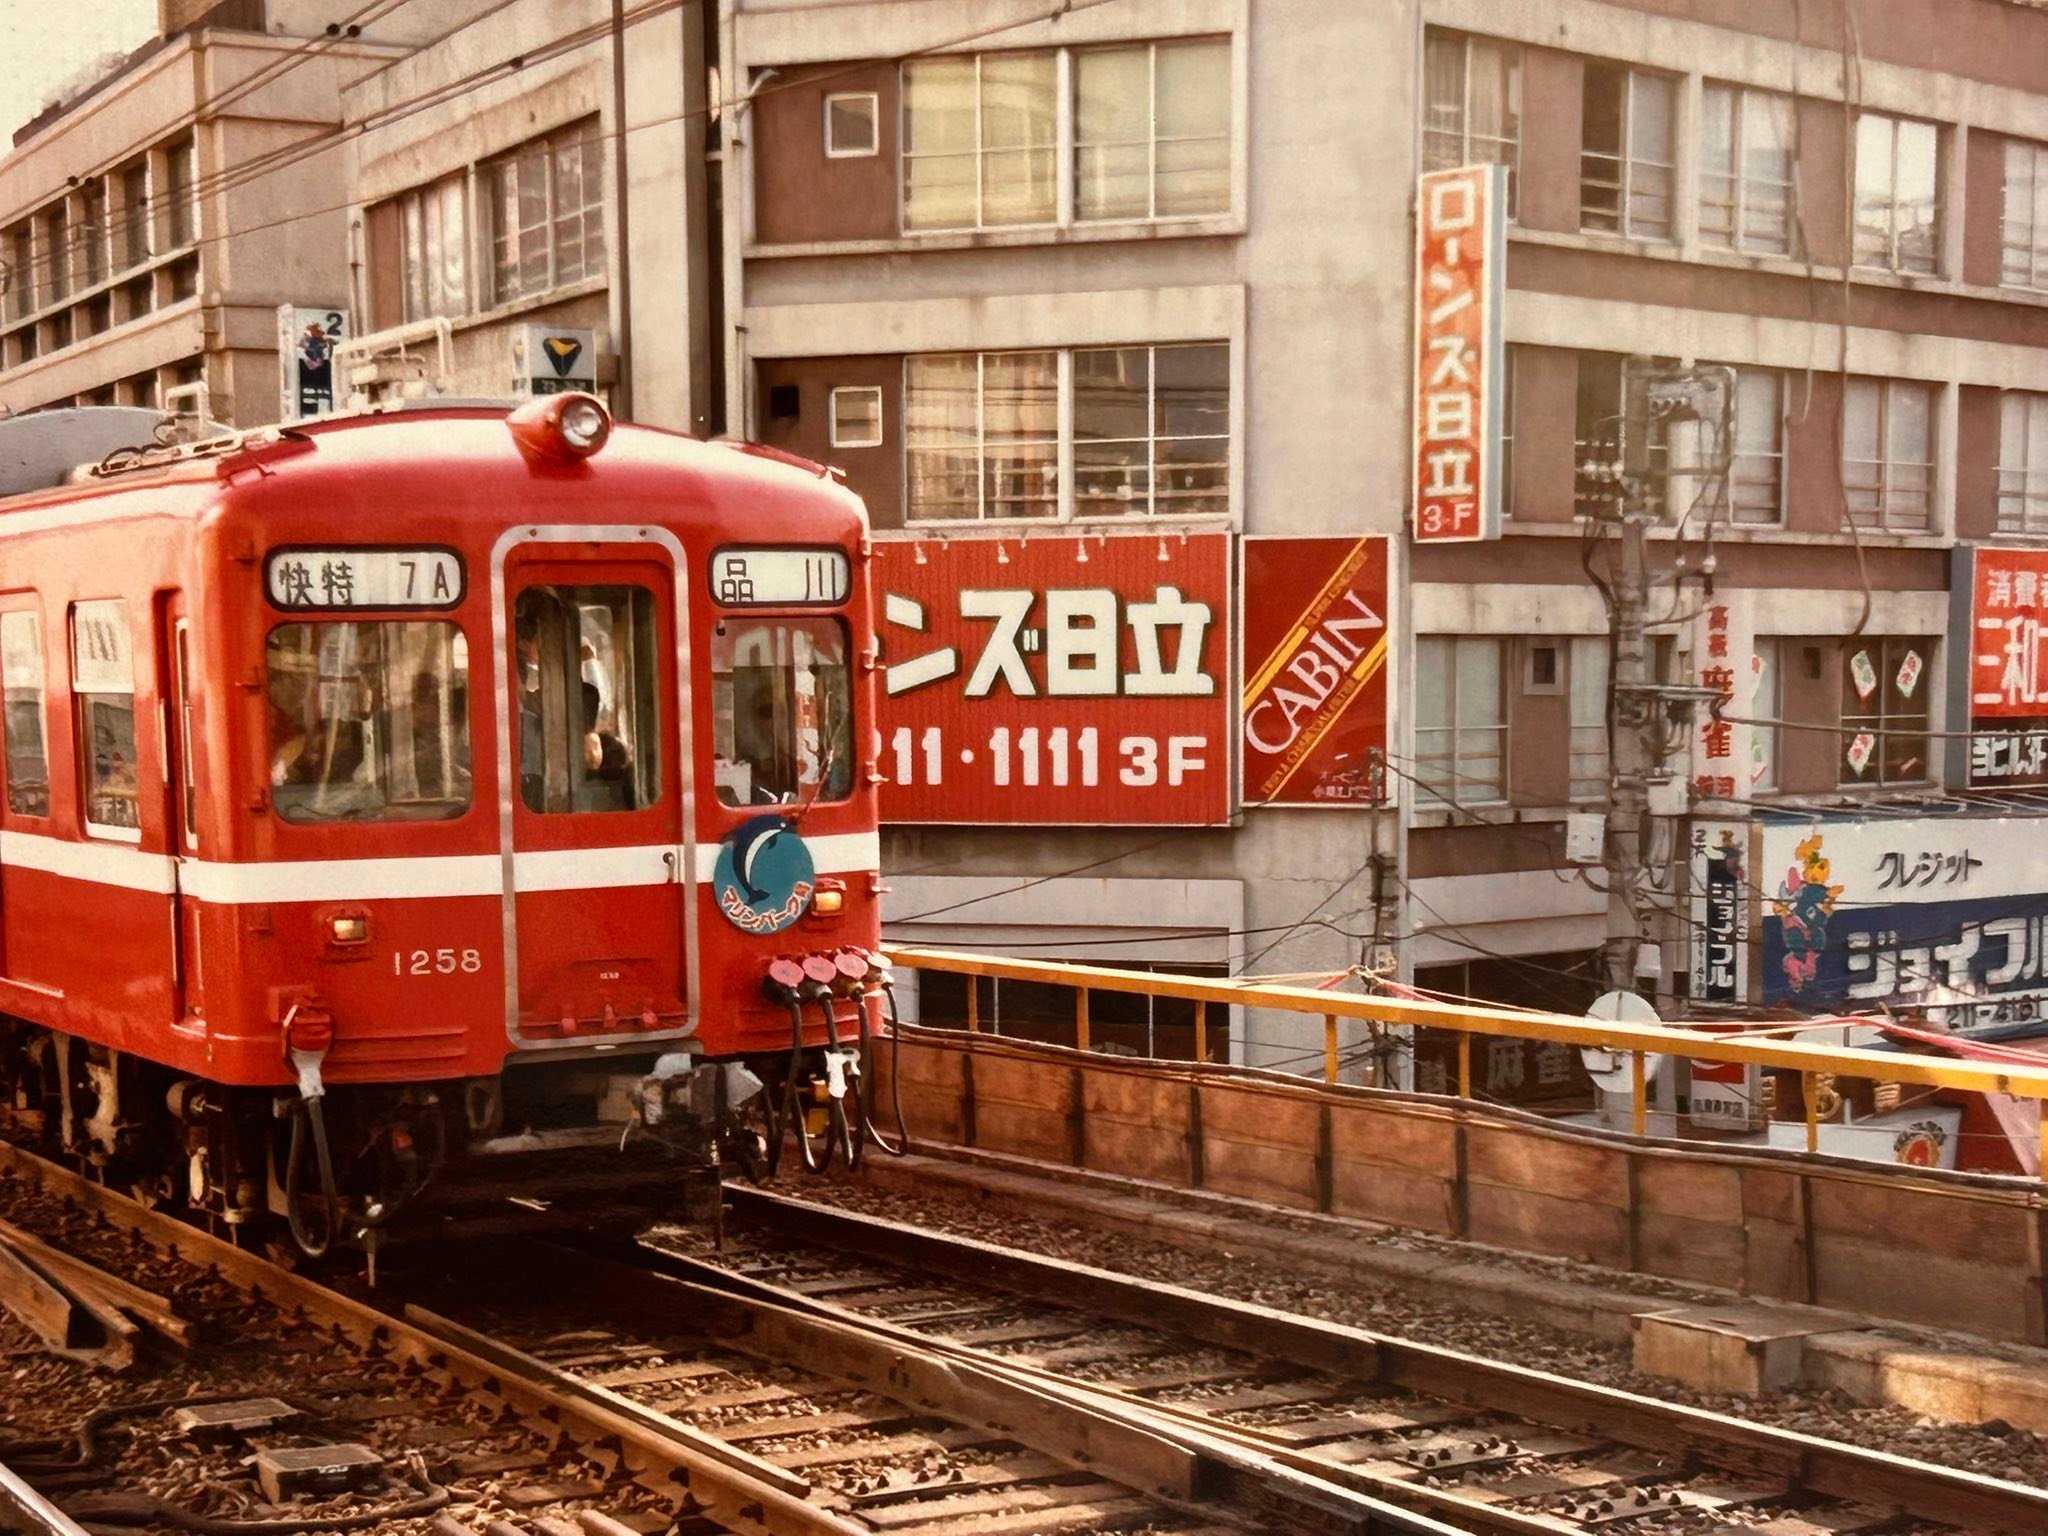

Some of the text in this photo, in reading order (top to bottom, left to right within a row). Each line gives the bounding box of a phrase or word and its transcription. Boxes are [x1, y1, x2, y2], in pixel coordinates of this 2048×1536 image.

[1423, 179, 1477, 498] ローンズ日立
[279, 560, 354, 605] 快特
[721, 559, 837, 601] 品川
[1987, 569, 2048, 608] 消費
[1246, 589, 1384, 754] CABIN
[1119, 736, 1207, 786] 3F
[1875, 849, 1983, 890] クレジット
[394, 948, 481, 976] 1258
